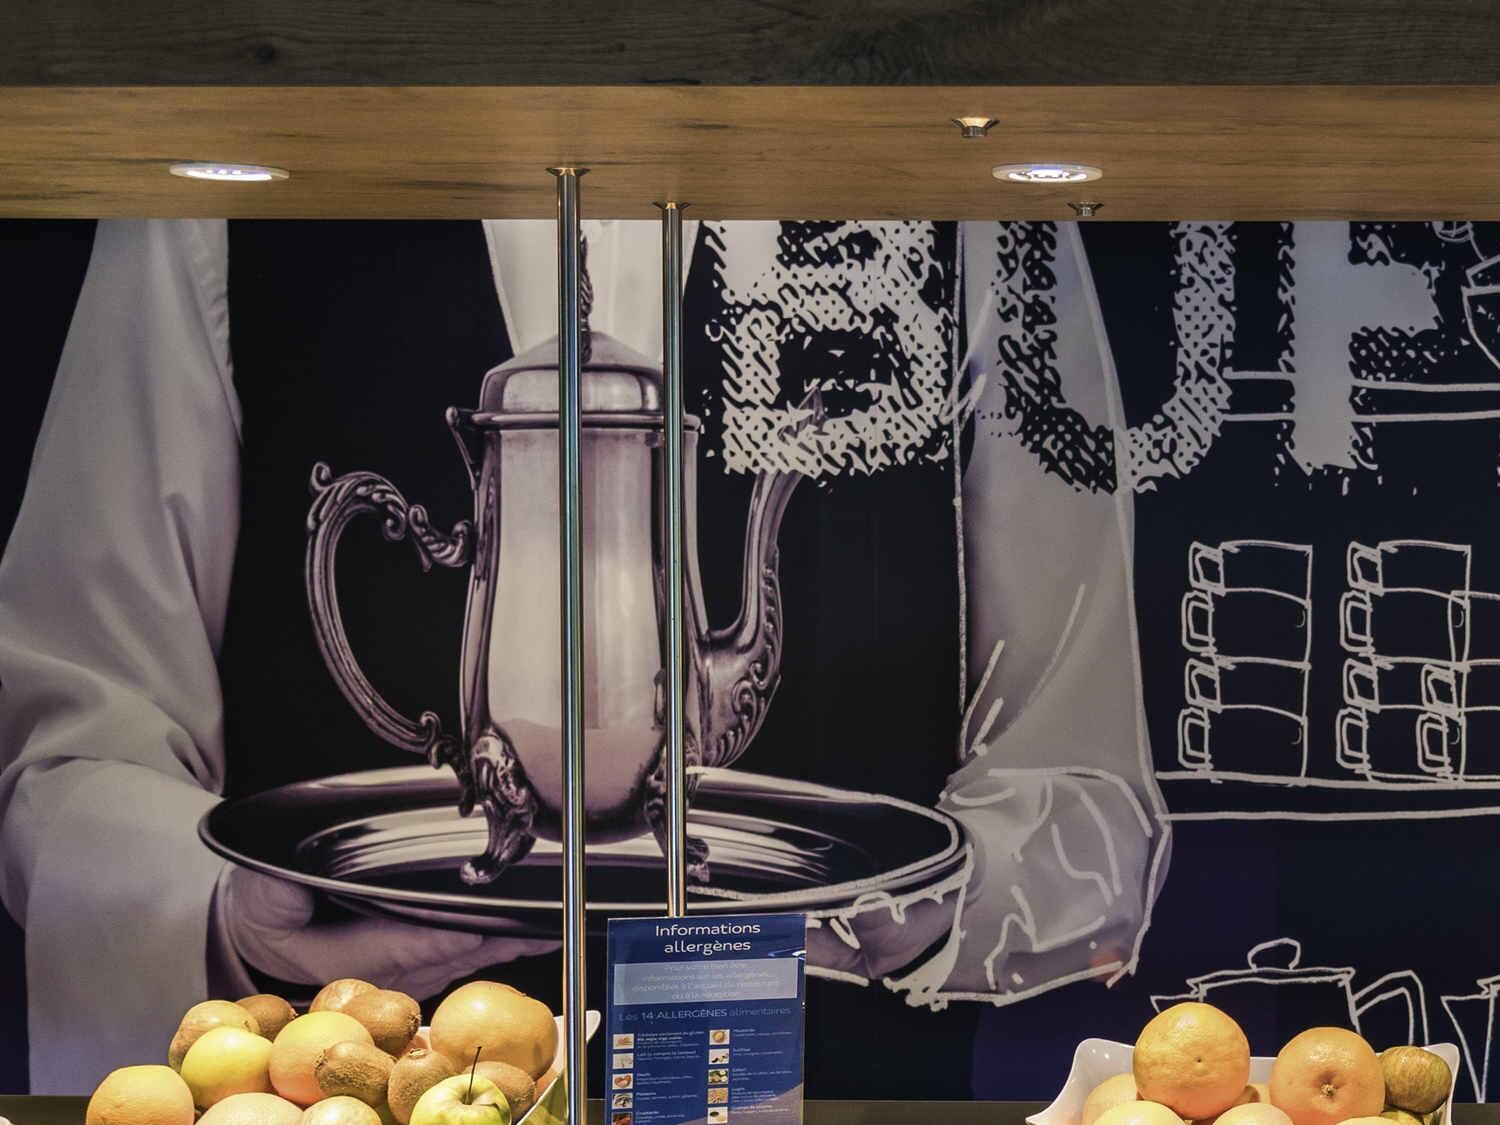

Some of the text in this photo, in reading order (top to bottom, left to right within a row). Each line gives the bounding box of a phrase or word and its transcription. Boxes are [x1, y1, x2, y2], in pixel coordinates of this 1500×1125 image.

[655, 922, 761, 937] Informations
[664, 940, 752, 956] allergènes
[641, 1012, 654, 1022] 14
[729, 1006, 792, 1017] alimentaires
